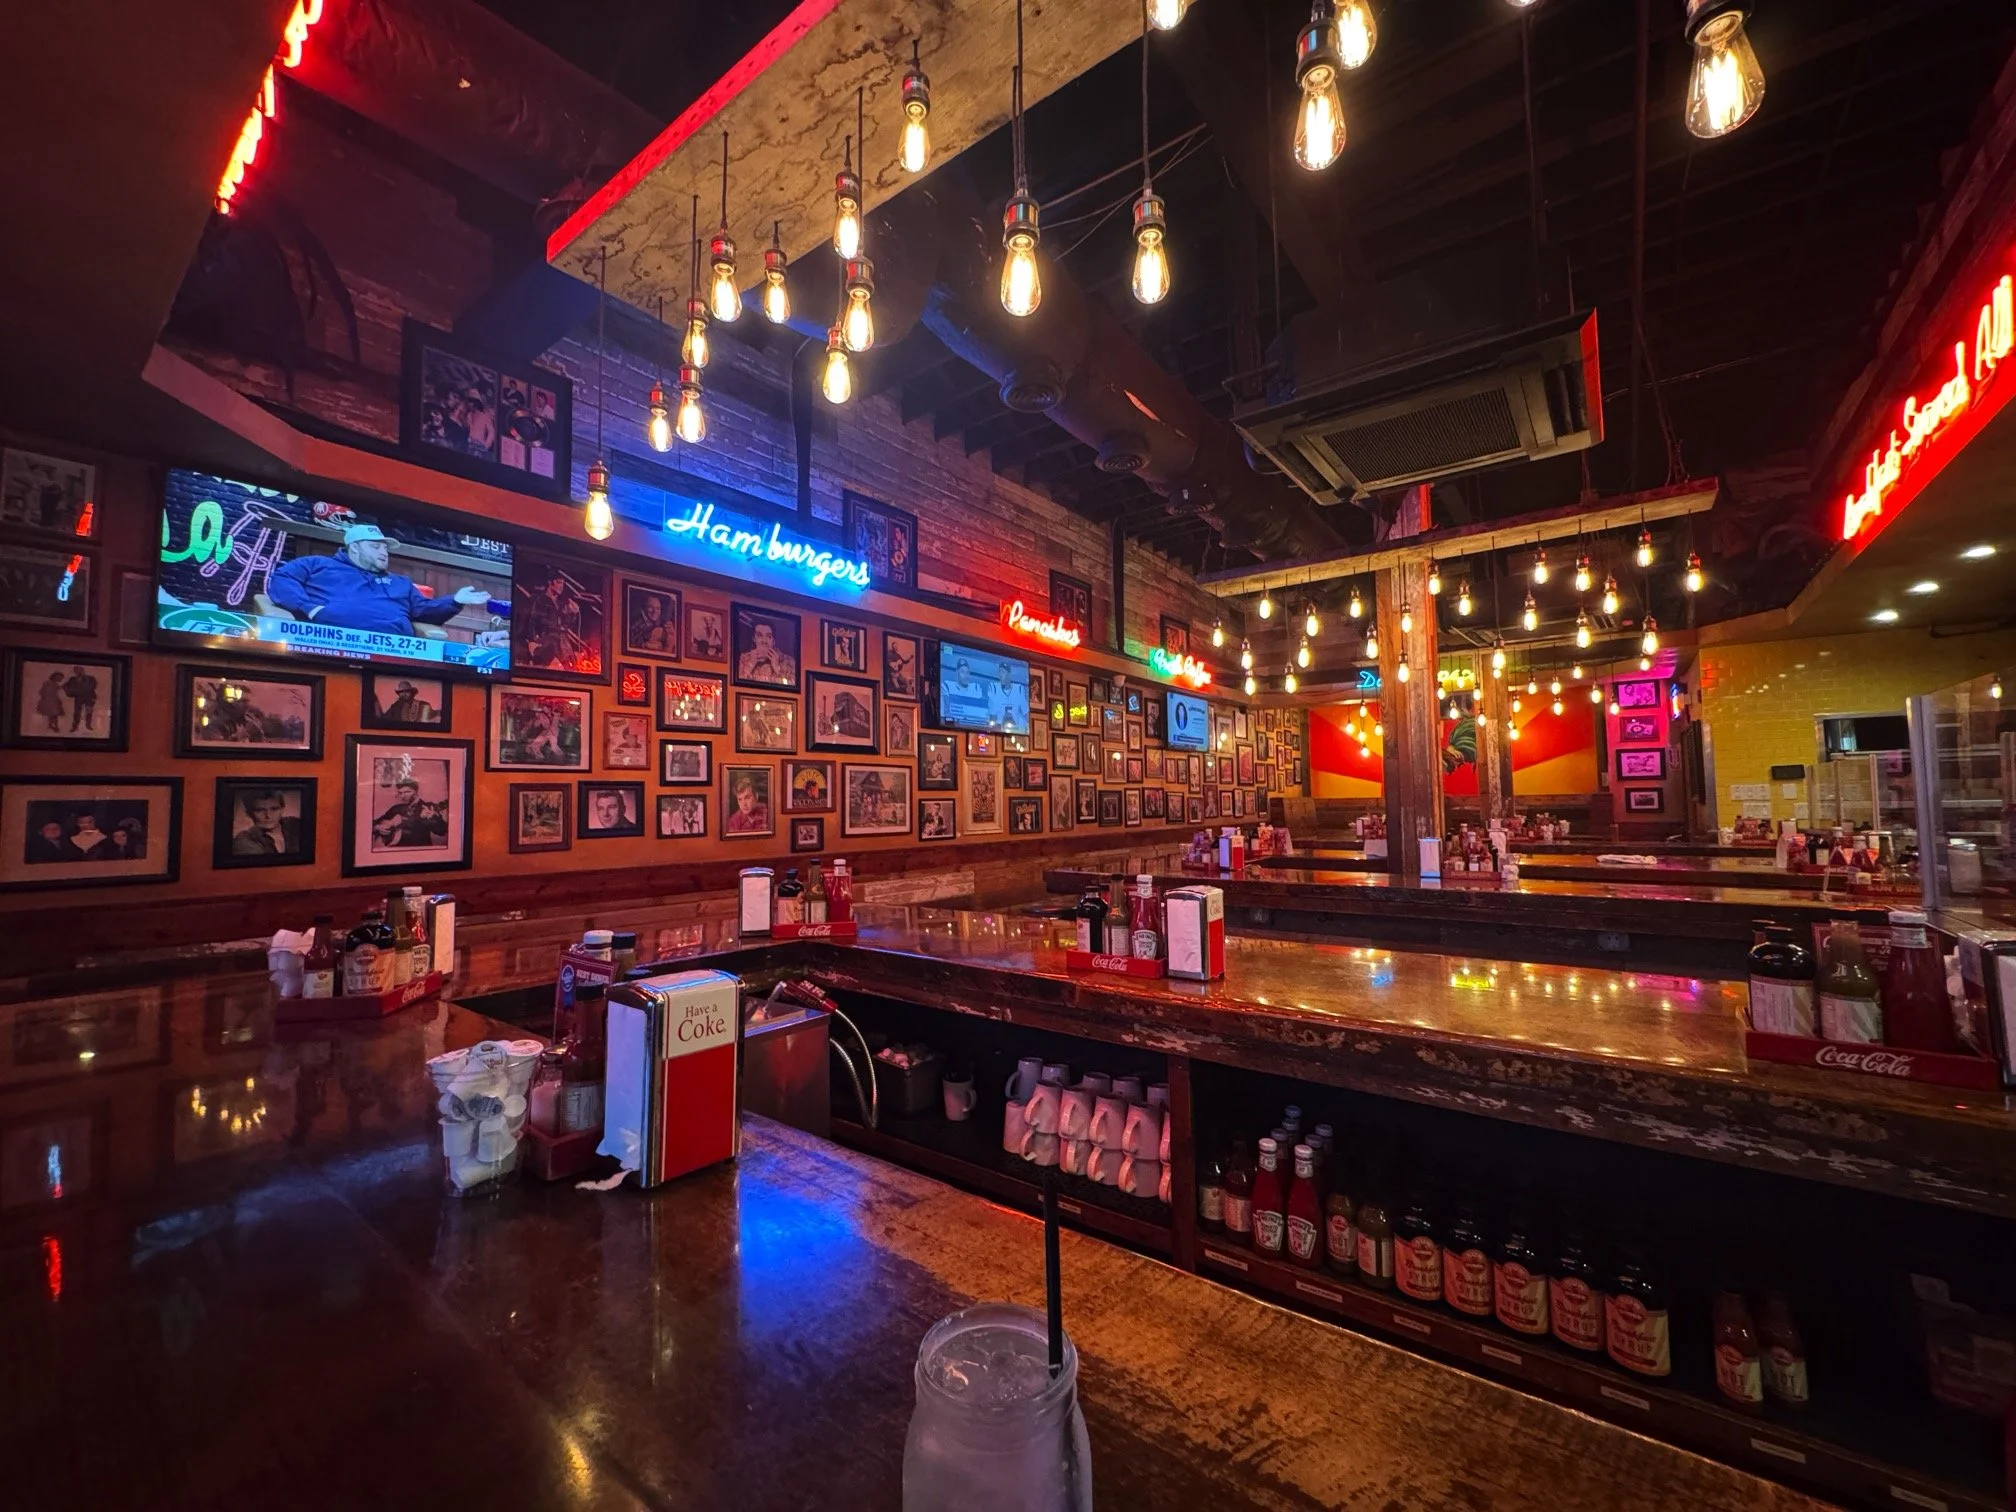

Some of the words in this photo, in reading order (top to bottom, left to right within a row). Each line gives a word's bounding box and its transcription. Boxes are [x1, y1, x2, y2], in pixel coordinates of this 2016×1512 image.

[667, 502, 871, 586] Hamburgers
[280, 622, 343, 641] DOLPHINS
[346, 633, 362, 643] DEF.
[364, 633, 396, 649] JETS,
[398, 638, 428, 651] 27-21
[1008, 600, 1080, 647] Pancakes
[286, 645, 340, 657] BREAKING
[343, 651, 371, 660] NEWS
[477, 666, 493, 674] FS1
[1183, 655, 1212, 687] Coffee
[1091, 955, 1129, 971] Coca-Cola
[685, 1005, 710, 1019] Have
[712, 1003, 718, 1012] a
[678, 1016, 726, 1042] Coke
[1815, 1046, 1915, 1076] Coca-Cola
